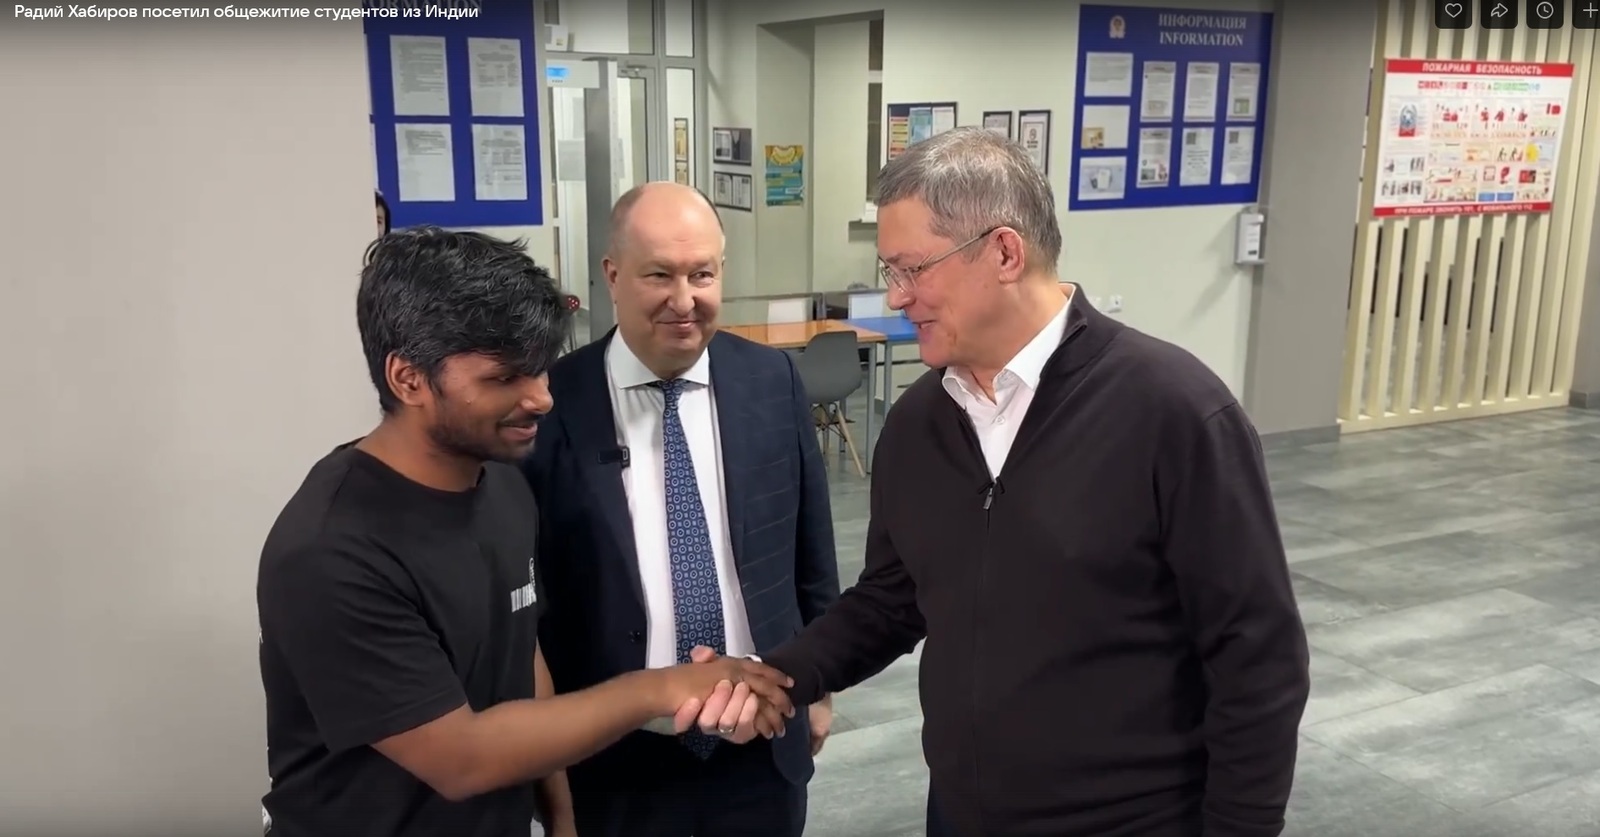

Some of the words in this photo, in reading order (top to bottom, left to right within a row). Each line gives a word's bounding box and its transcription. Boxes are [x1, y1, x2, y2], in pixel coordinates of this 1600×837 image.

[1158, 13, 1247, 30] ИНФОРМАЦИЯ
[1160, 32, 1244, 46] INFORMATION
[1422, 62, 1471, 73] ПОЖАРНАЯ
[1475, 64, 1542, 75] БЕЗОПАСНОСТЬ
